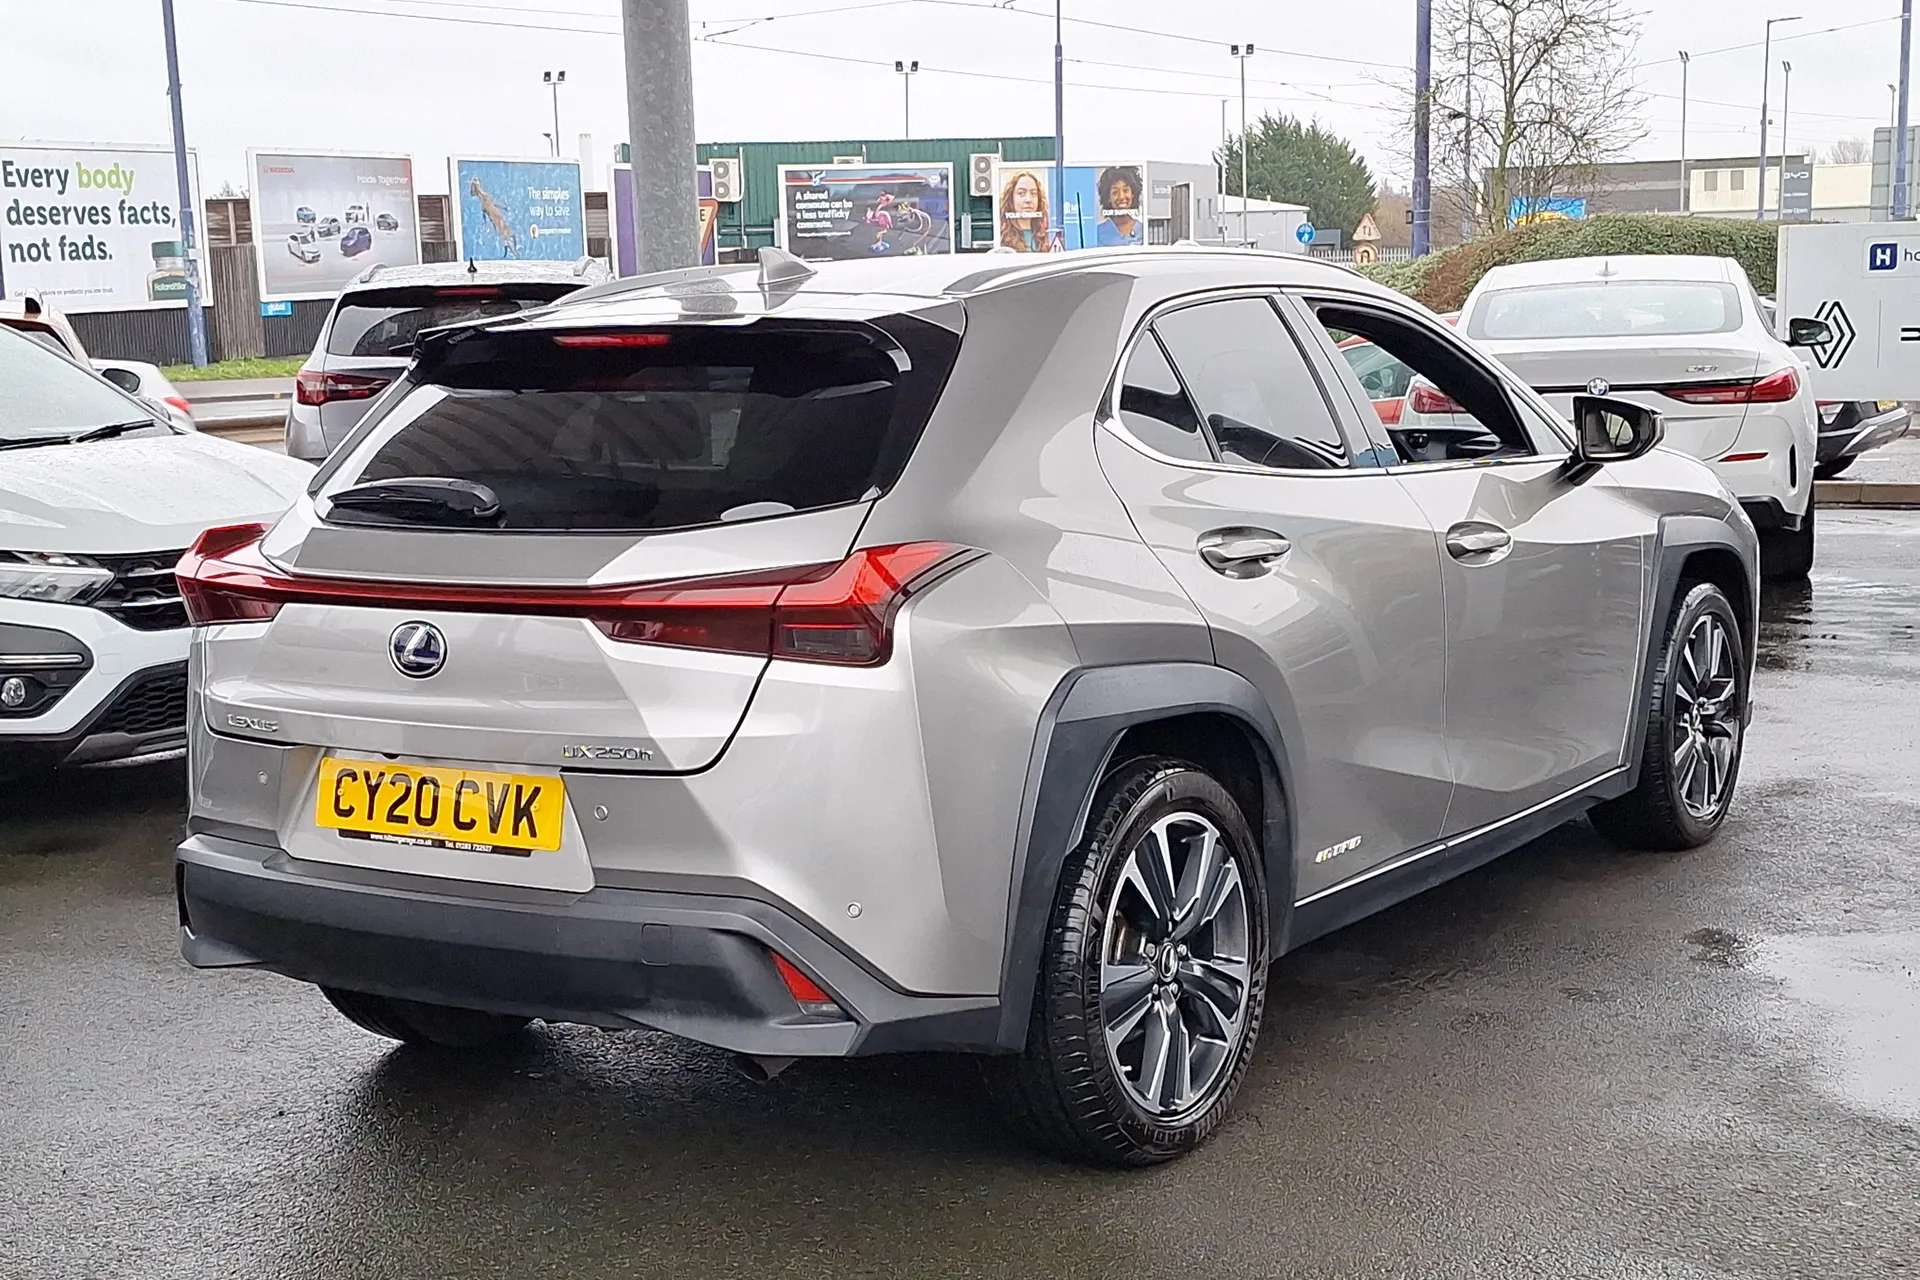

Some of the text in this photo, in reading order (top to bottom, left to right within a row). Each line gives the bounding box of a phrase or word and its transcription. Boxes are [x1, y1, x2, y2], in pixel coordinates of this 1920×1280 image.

[2, 160, 135, 196] Every body
[528, 186, 569, 203] The simples
[796, 190, 828, 200] A shared
[530, 205, 571, 219] way to save
[796, 201, 830, 209] commute
[843, 198, 853, 208] be
[6, 199, 176, 228] deserves facts,
[803, 210, 817, 219] less
[9, 234, 113, 263] not fads.
[227, 714, 278, 732] LEXUS
[333, 767, 542, 839] CY20 CVK
